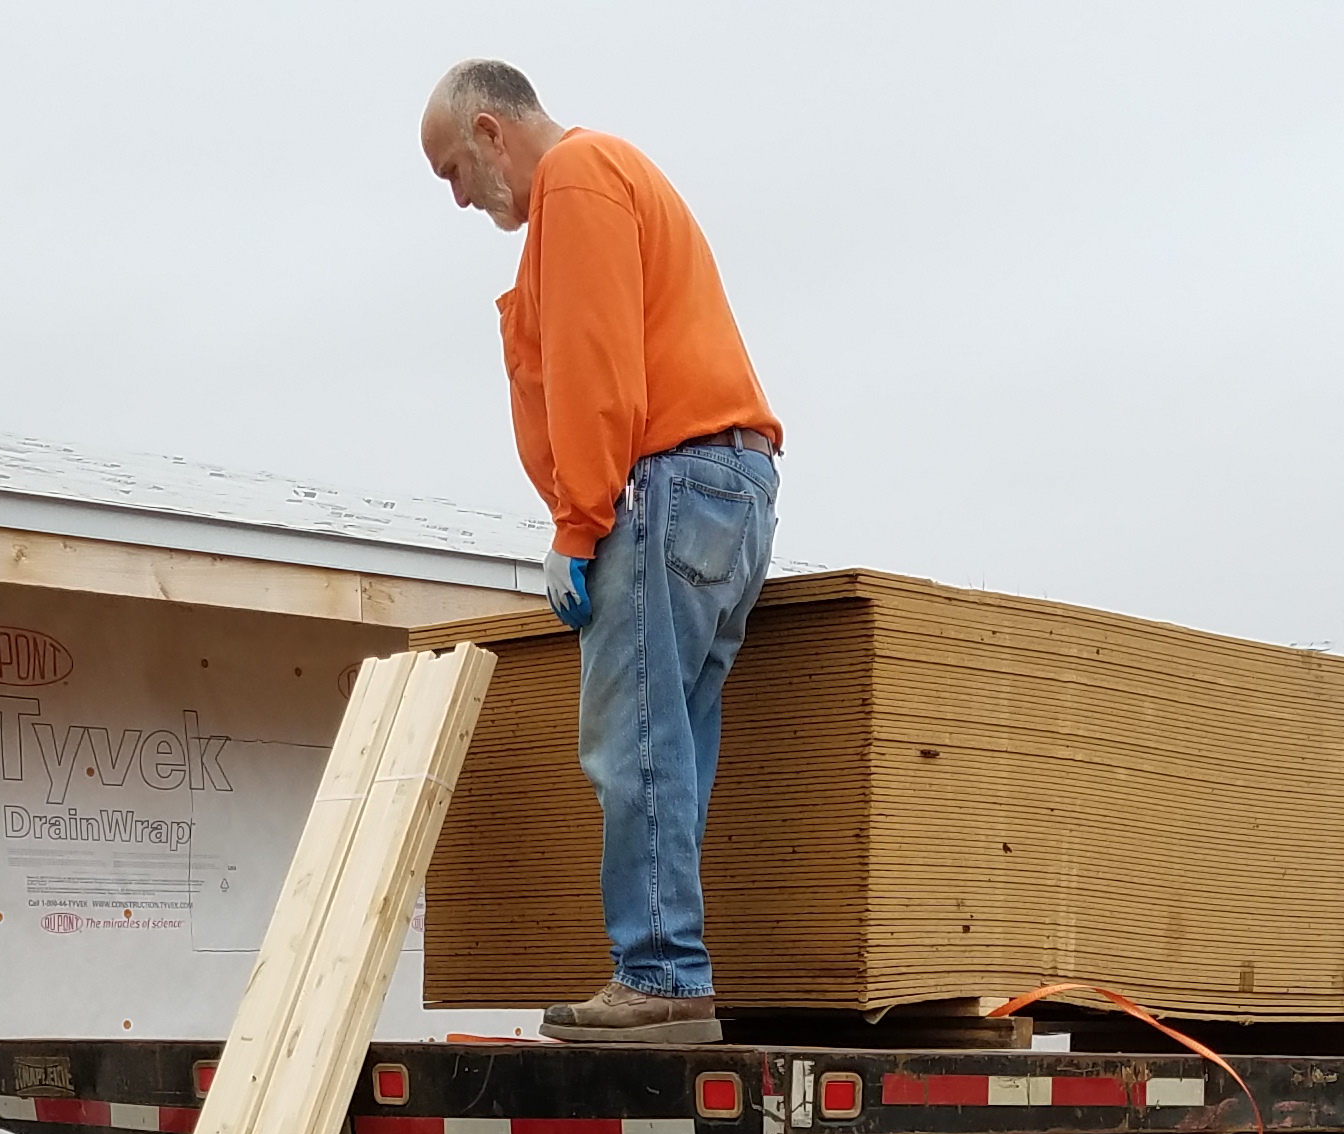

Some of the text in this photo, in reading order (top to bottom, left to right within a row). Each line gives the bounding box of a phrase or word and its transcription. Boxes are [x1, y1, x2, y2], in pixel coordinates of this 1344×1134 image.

[3, 804, 192, 852] DrainWrap
[86, 918, 100, 928] The
[103, 918, 141, 929] miracles
[142, 918, 151, 931] of
[152, 919, 183, 930] science
